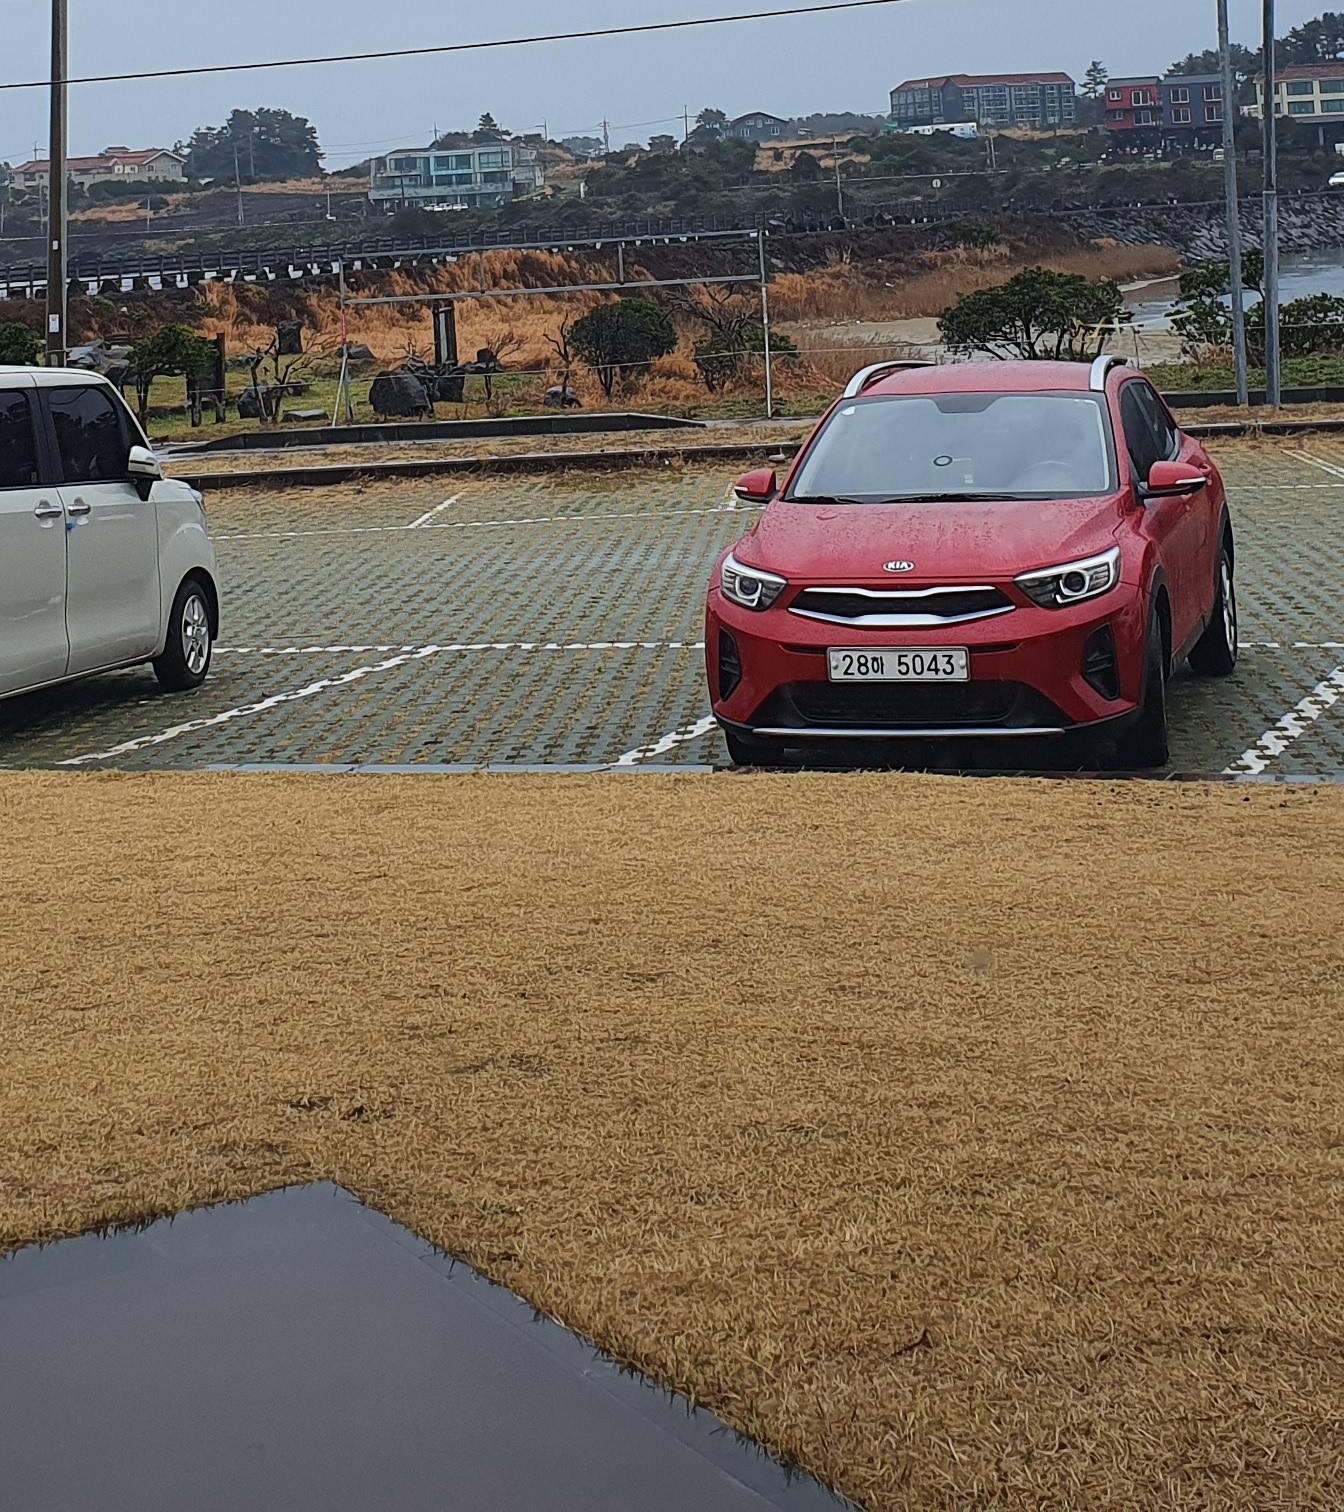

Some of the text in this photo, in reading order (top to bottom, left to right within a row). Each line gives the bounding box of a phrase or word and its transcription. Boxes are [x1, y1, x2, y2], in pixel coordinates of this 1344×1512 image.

[887, 561, 909, 569] KIA
[842, 654, 955, 676] 28하 5043
